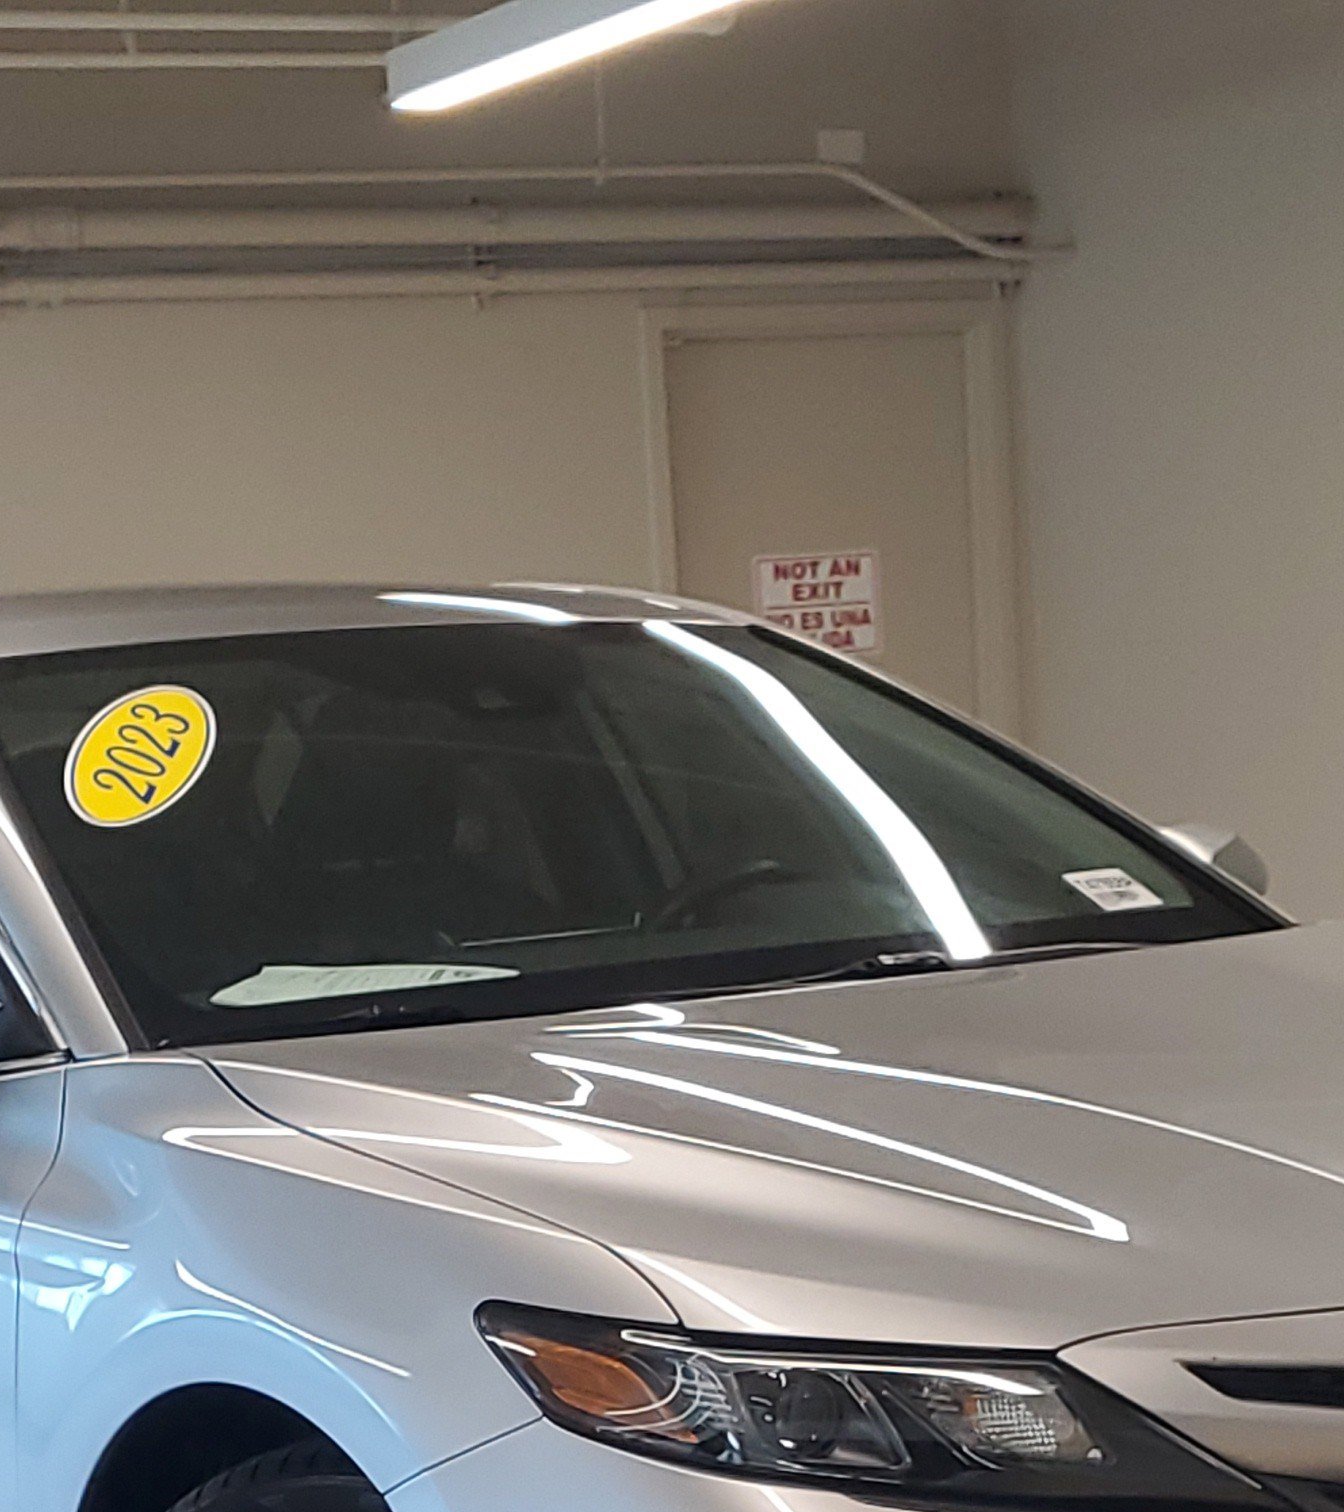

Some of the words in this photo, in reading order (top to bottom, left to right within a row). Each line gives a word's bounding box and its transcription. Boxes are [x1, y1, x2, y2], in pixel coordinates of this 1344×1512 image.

[773, 561, 819, 581] NOT
[829, 558, 860, 577] AN
[792, 581, 843, 602] EXIT
[800, 611, 823, 631] ES
[92, 703, 190, 805] 2023
